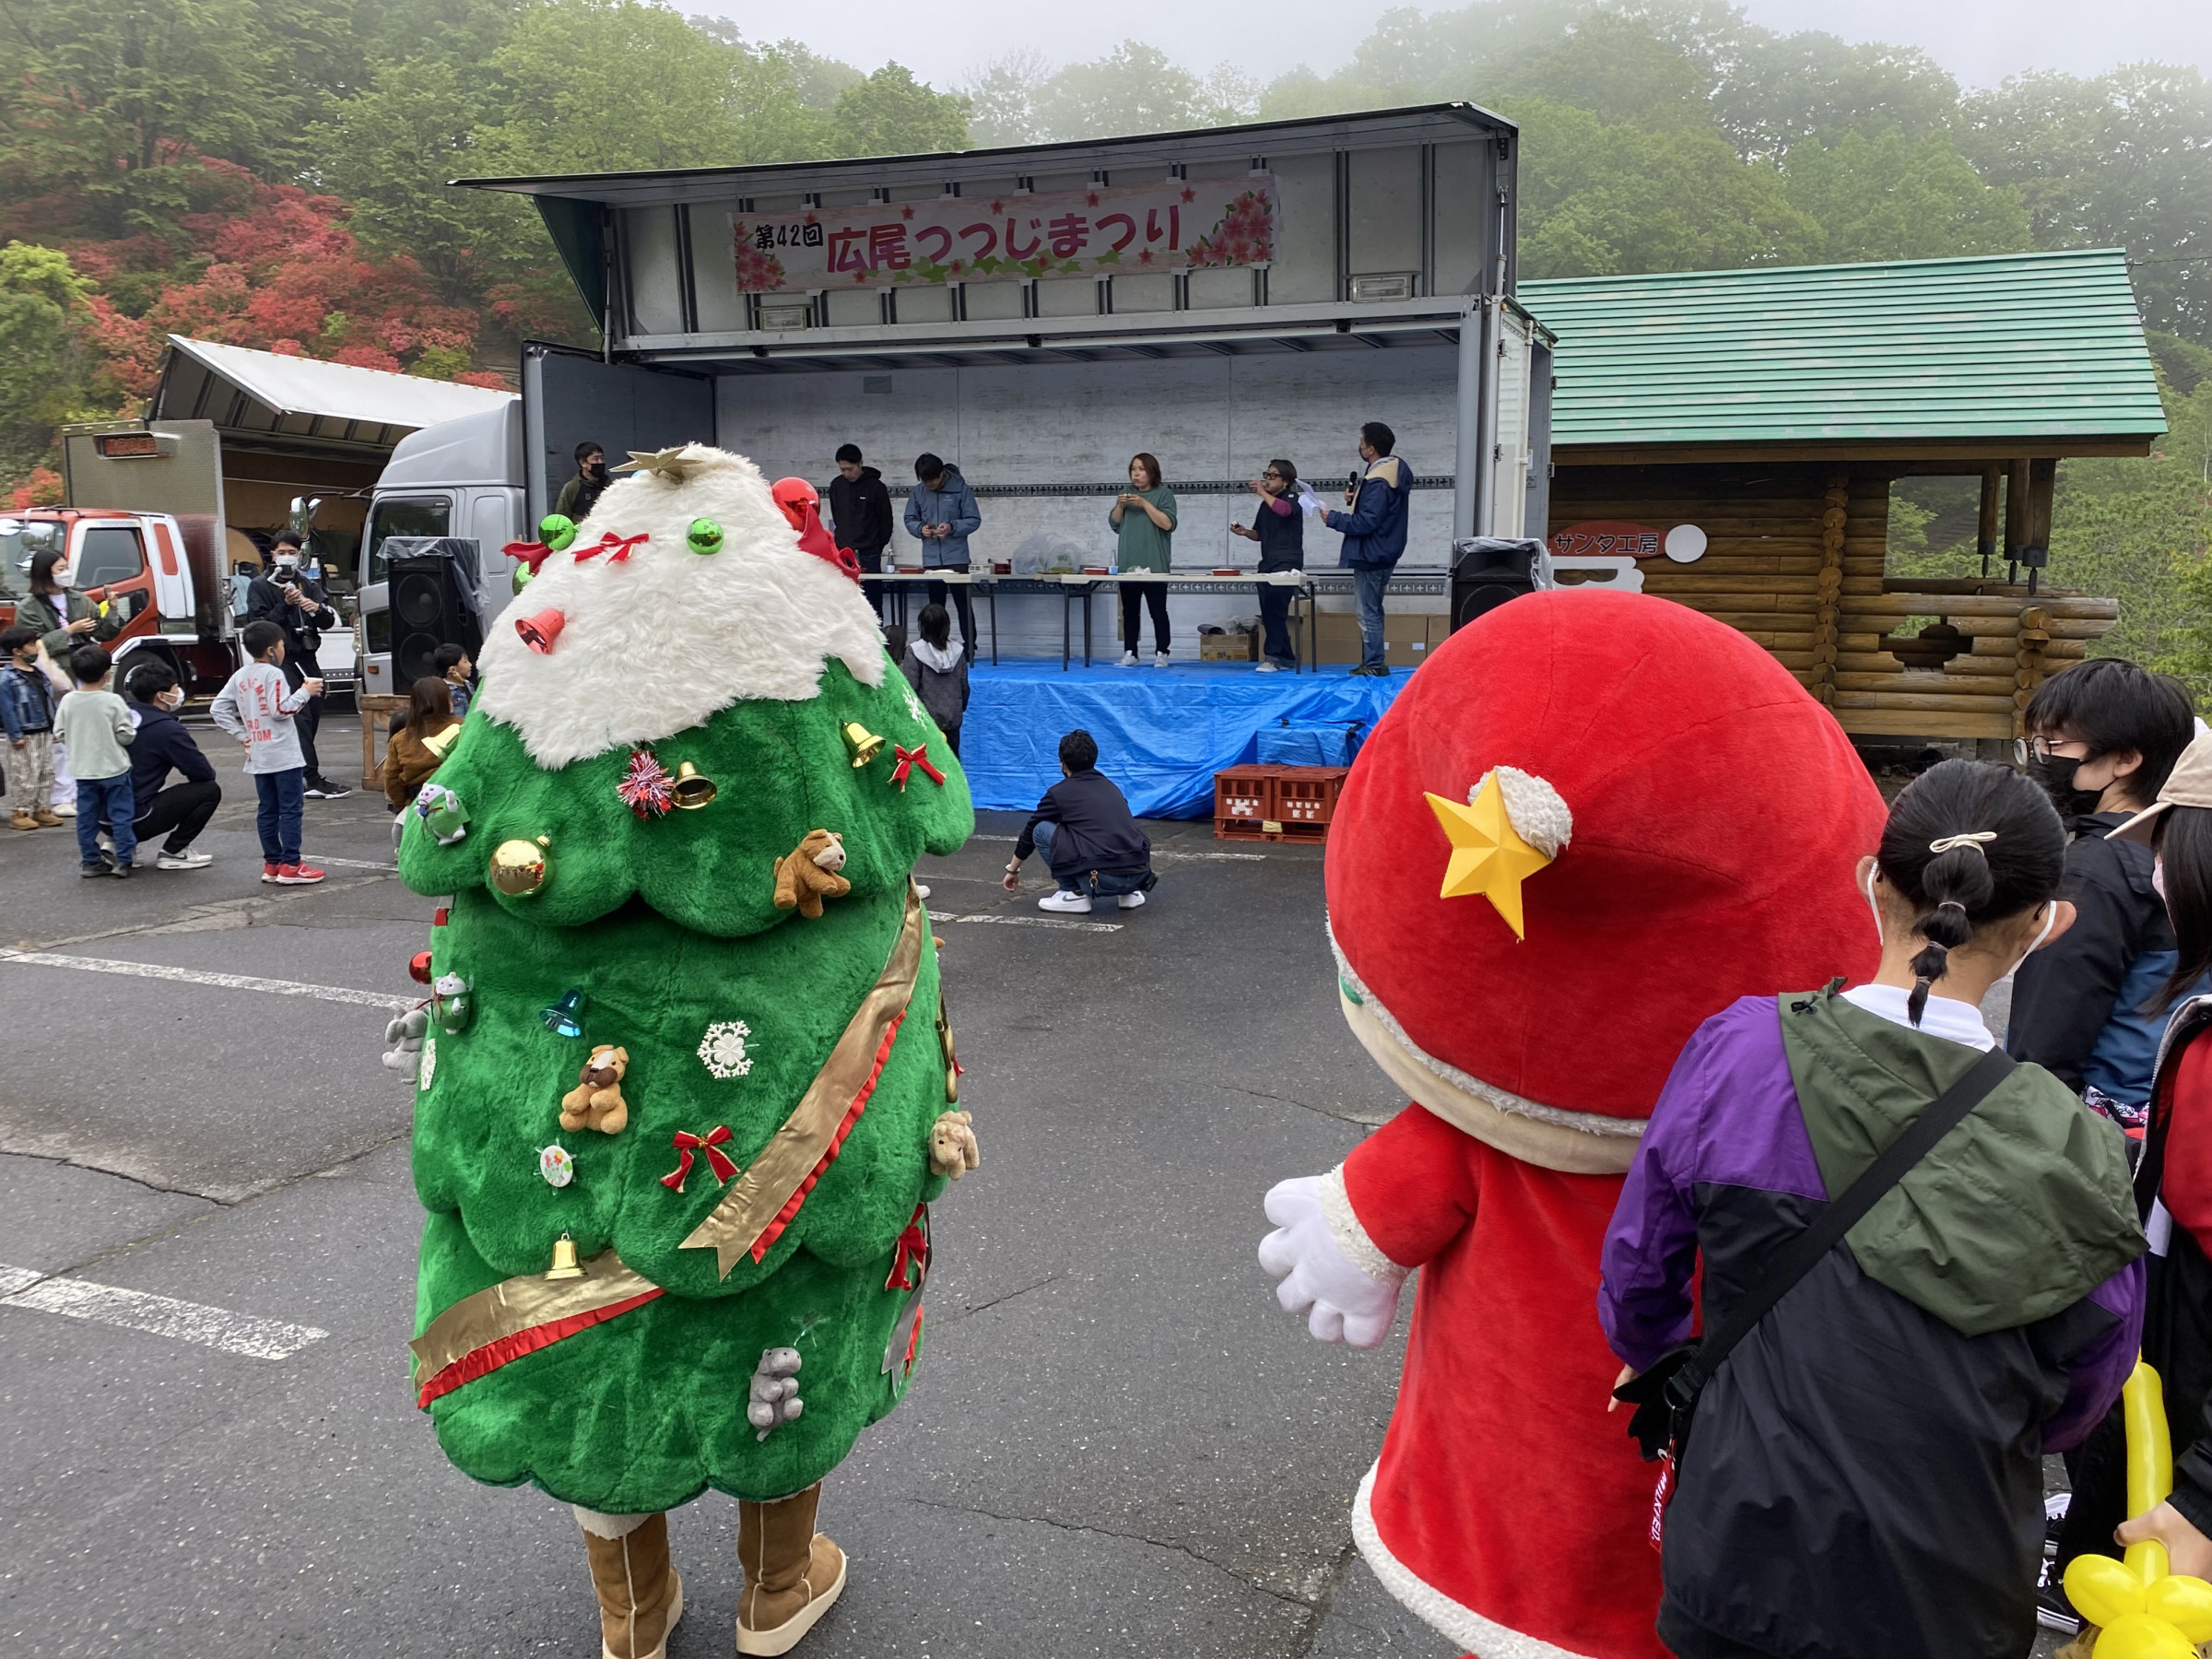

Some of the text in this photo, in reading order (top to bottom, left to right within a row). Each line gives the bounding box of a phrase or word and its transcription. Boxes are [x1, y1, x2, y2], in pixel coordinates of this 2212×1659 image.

[754, 204, 1180, 273] 第42回 広尾つつじまつり
[1555, 533, 1659, 554] サンタ工房
